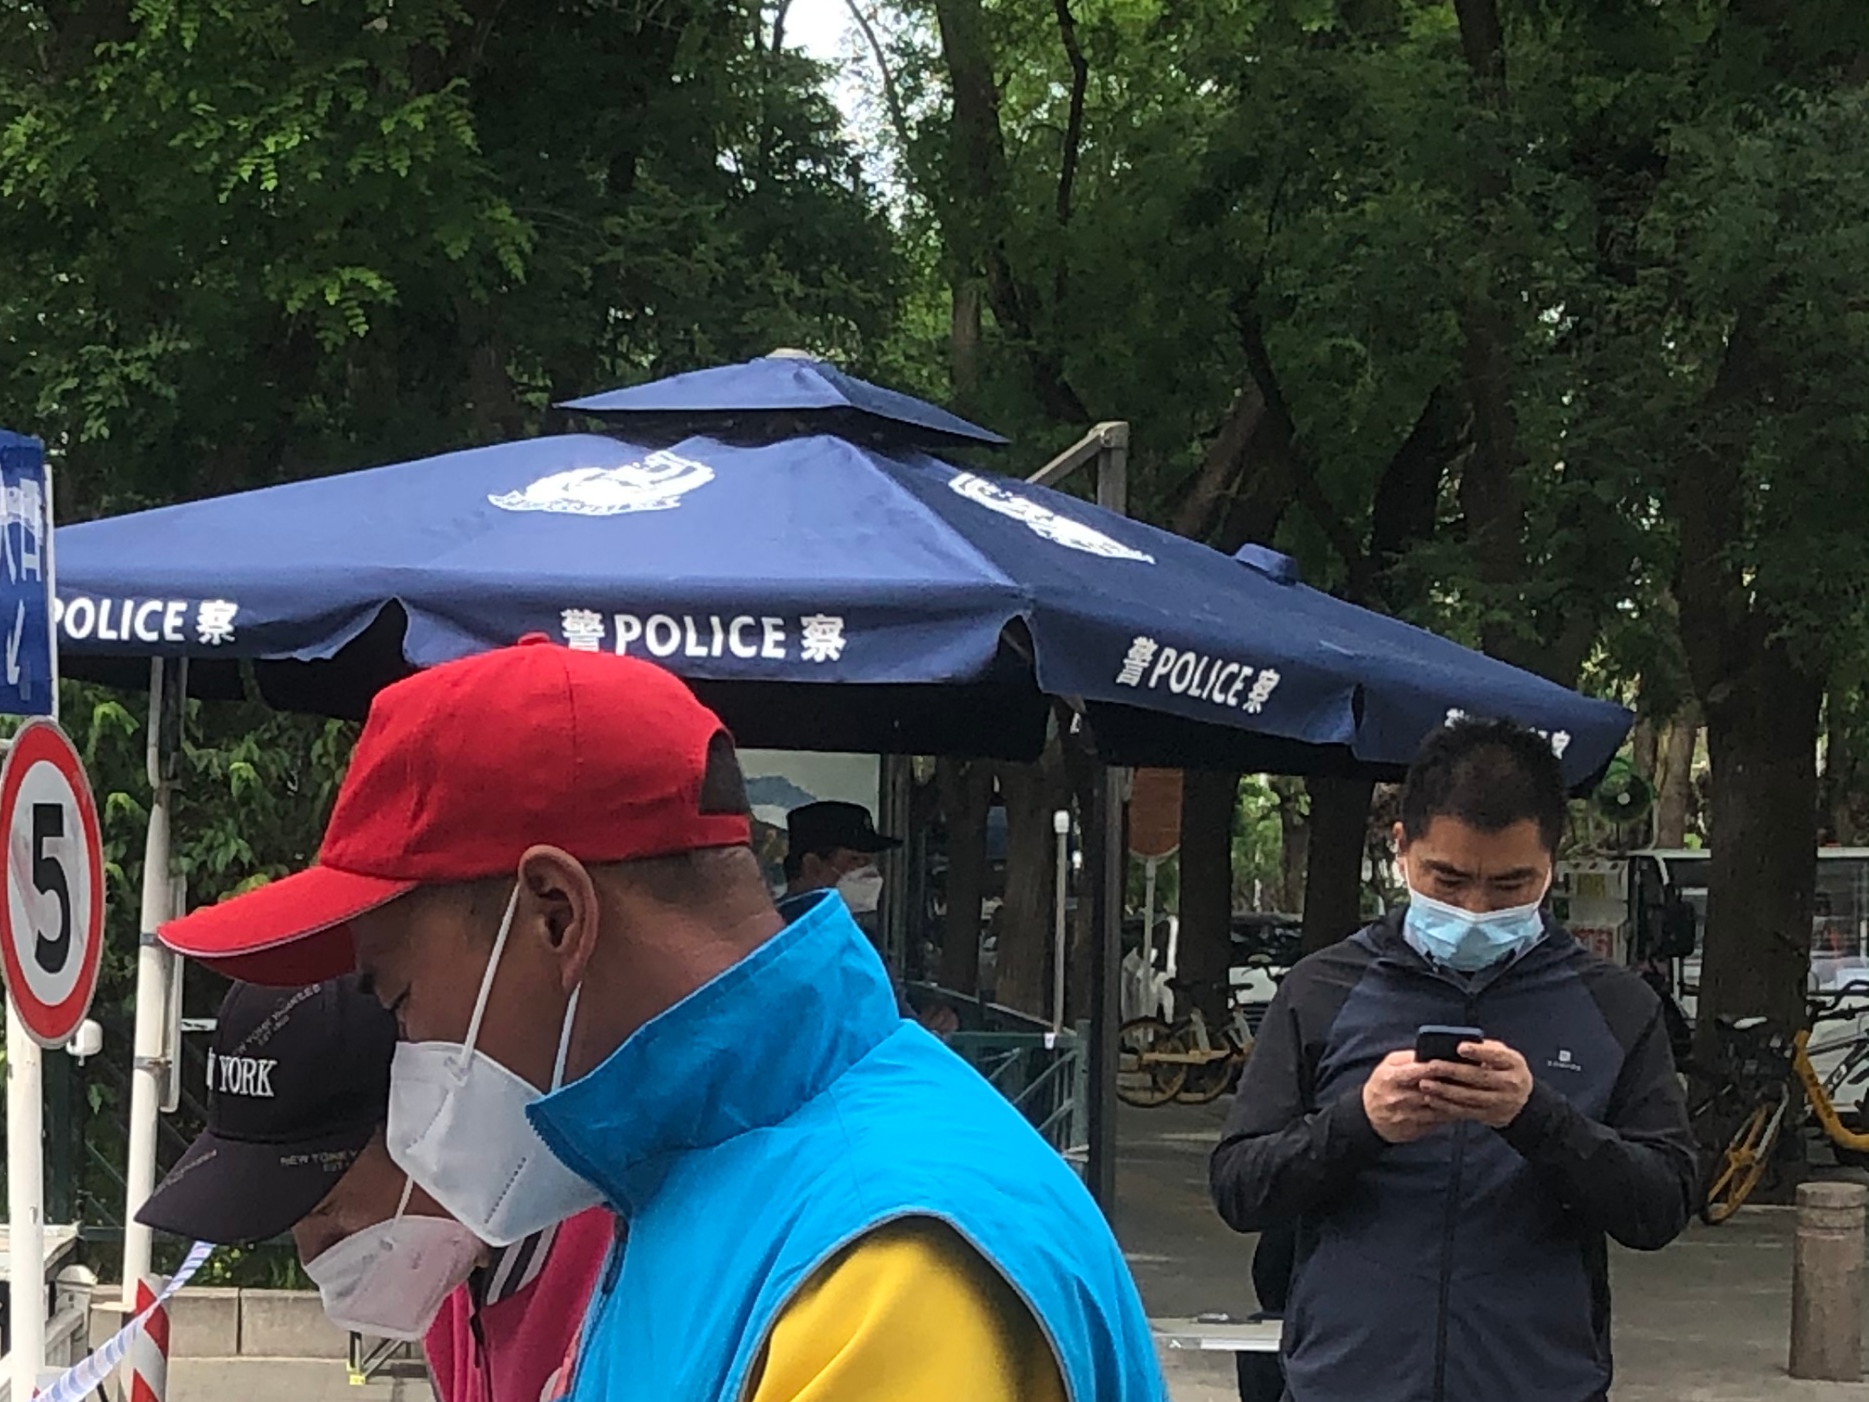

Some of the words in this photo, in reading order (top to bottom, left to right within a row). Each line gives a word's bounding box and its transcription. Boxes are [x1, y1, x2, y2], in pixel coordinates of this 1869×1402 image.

[196, 600, 239, 645] 察
[561, 609, 605, 652] 警
[614, 613, 786, 659] POLICE
[801, 614, 847, 663] 察
[1116, 636, 1159, 688] 警
[1148, 646, 1254, 707] POLICE
[1243, 668, 1281, 714] 察
[30, 803, 74, 974] 5
[218, 1054, 278, 1098] YORK
